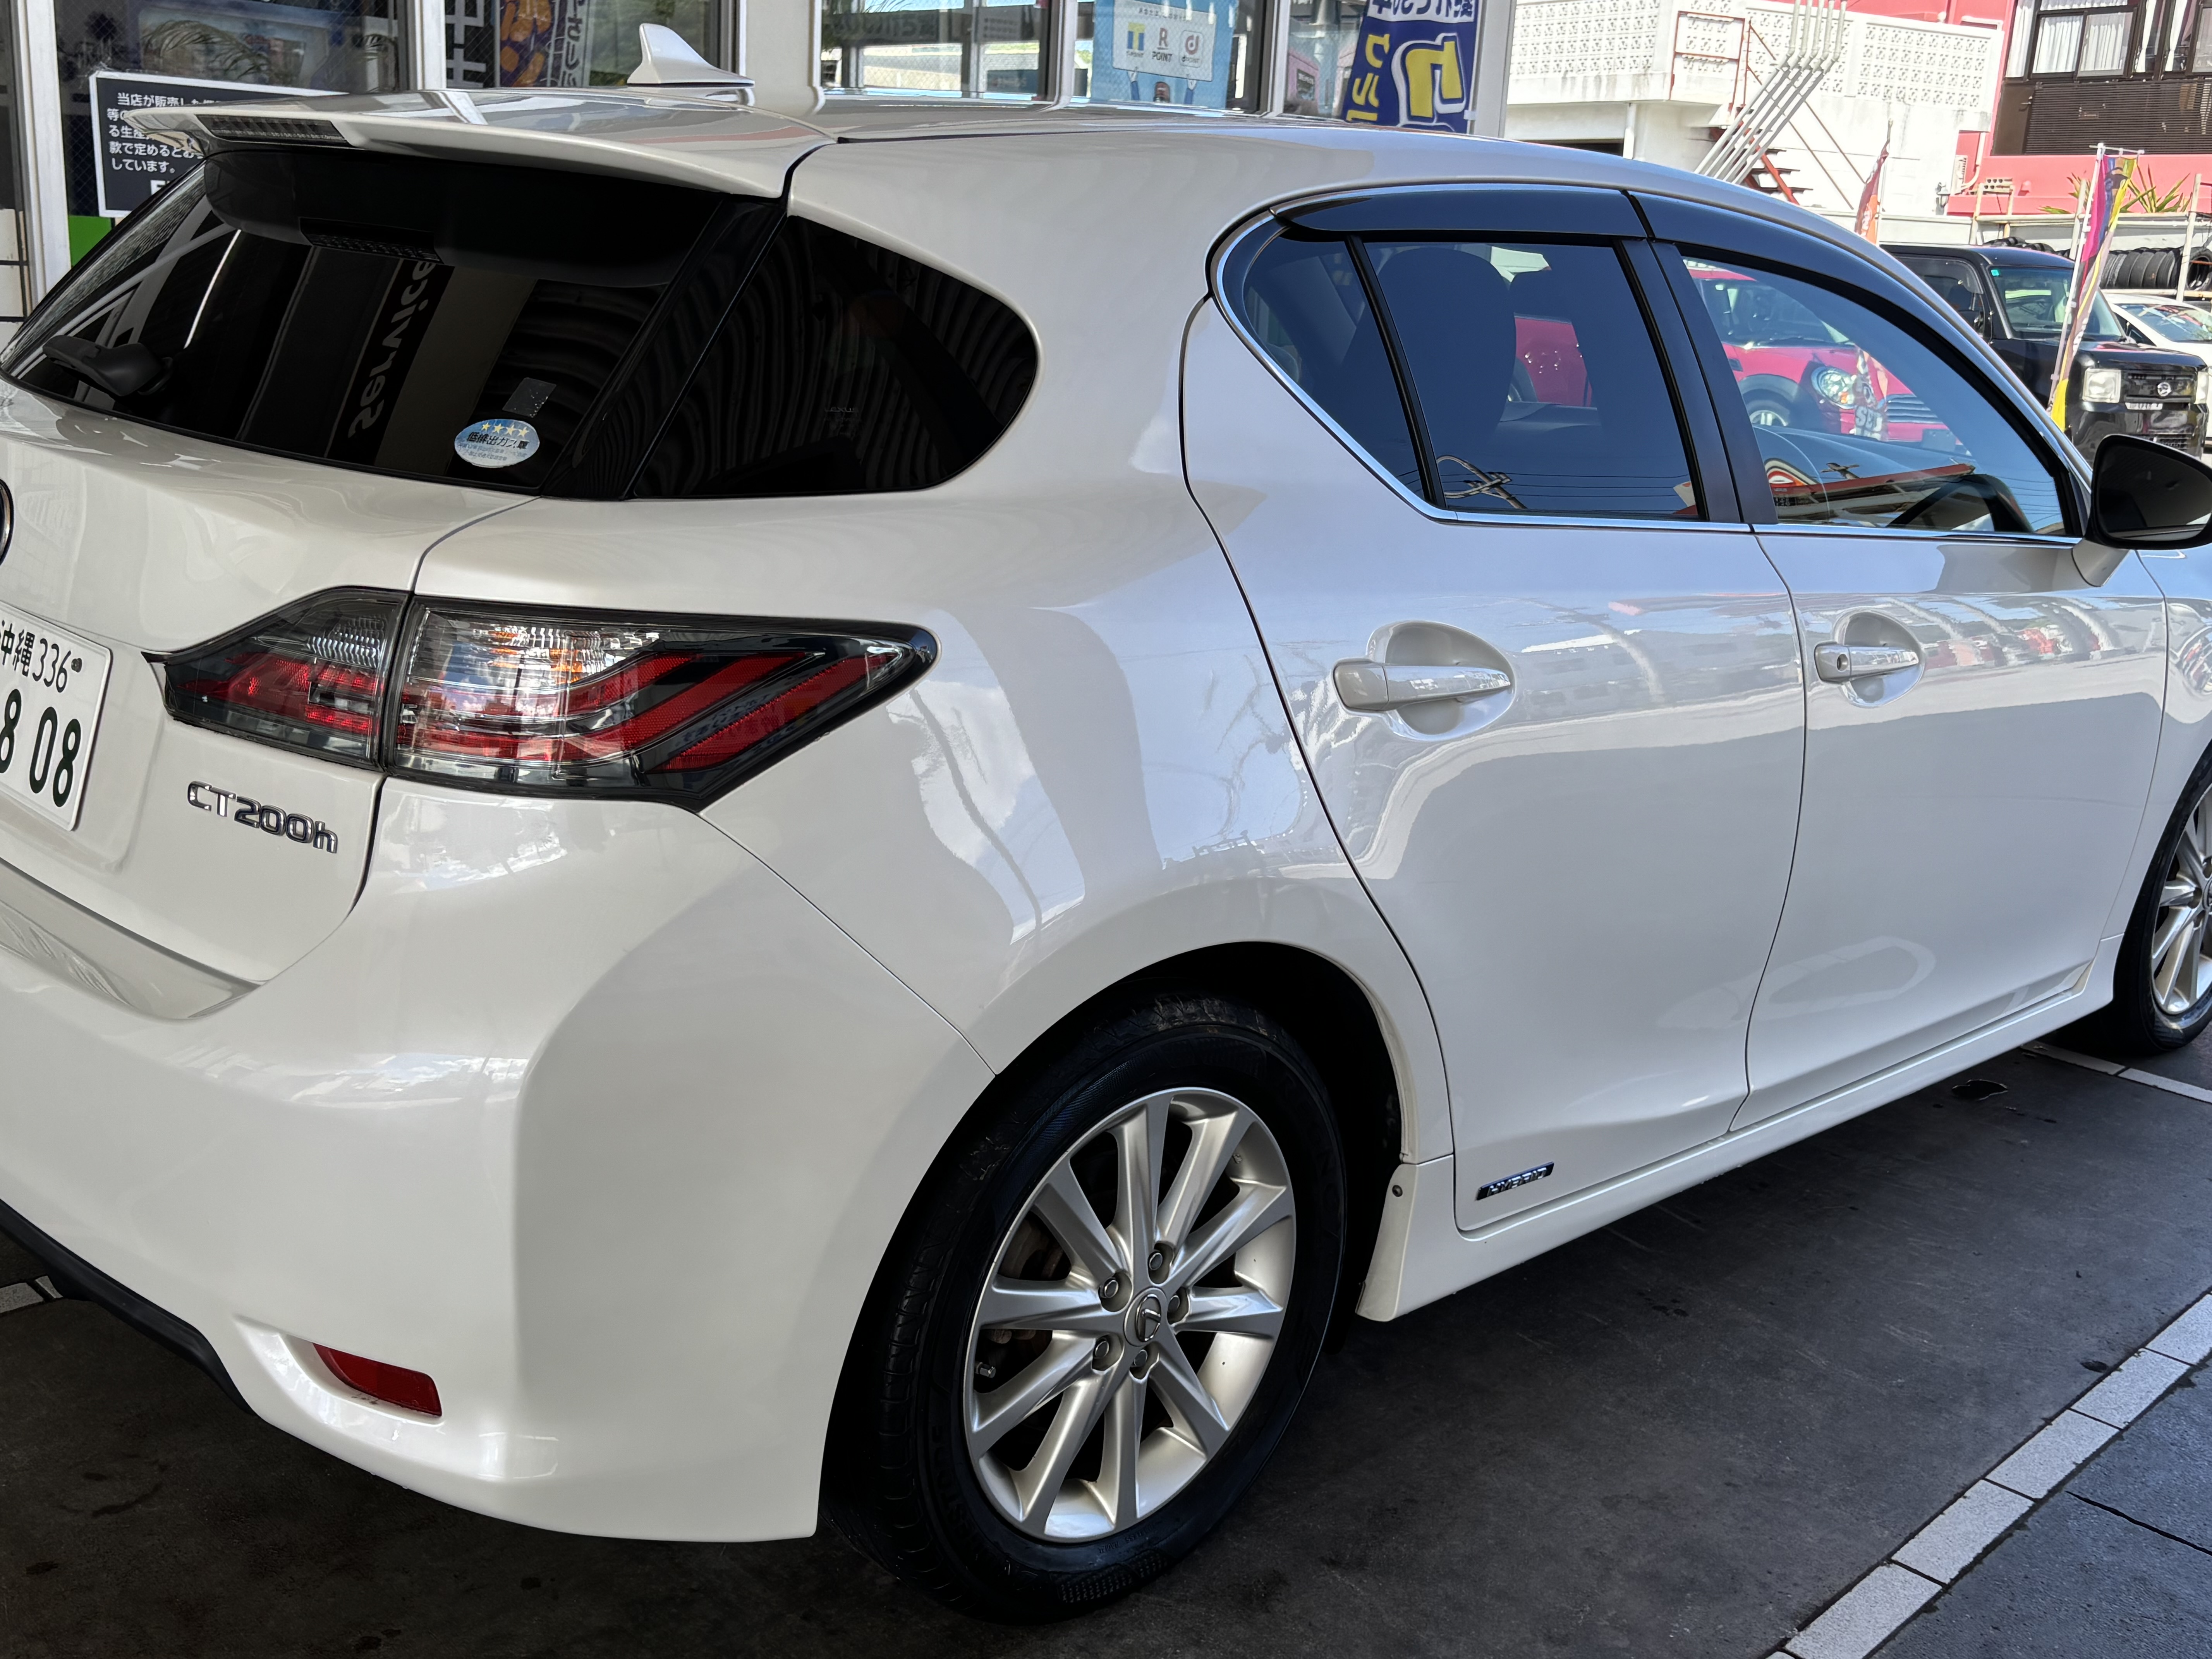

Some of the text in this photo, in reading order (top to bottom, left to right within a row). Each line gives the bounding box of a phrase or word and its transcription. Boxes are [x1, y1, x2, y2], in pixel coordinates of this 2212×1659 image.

[1152, 51, 1173, 62] POINT
[112, 158, 175, 173] しています。
[467, 431, 530, 450] 低排出ガス車
[0, 621, 72, 693] 沖縄 336
[1487, 1167, 1547, 1197] HYBRID
